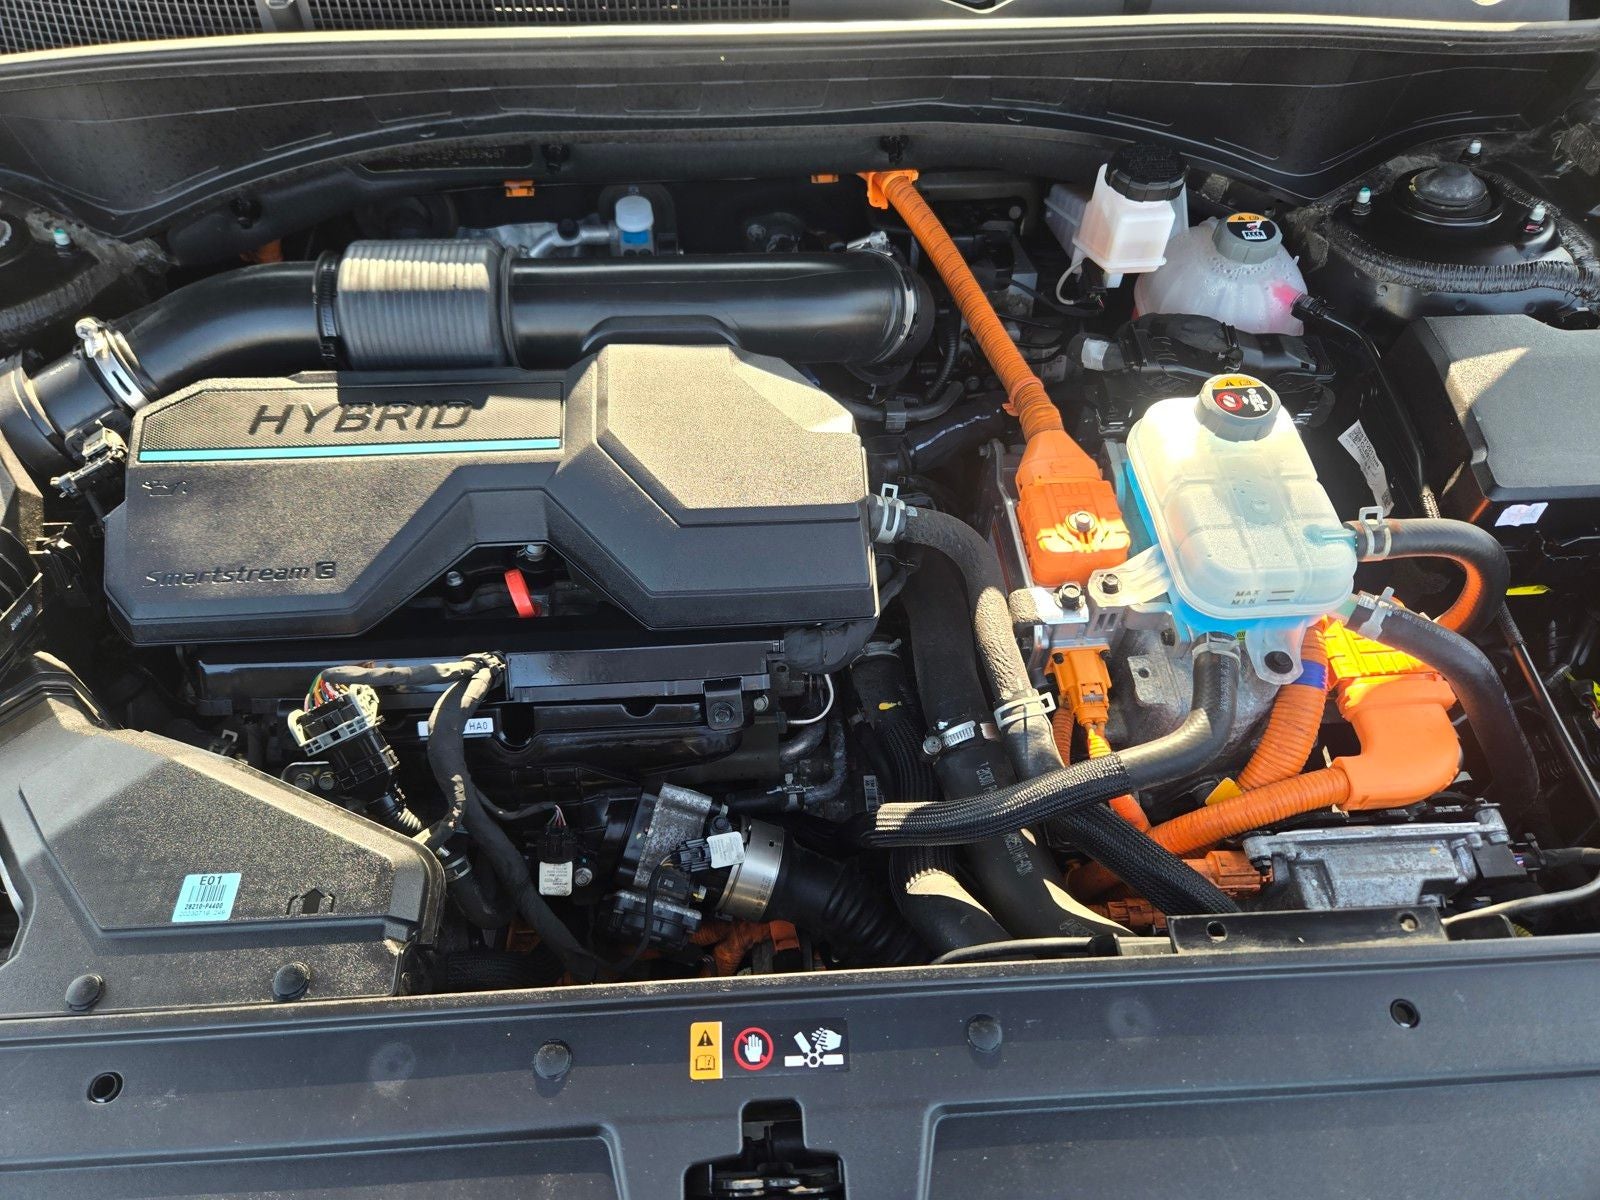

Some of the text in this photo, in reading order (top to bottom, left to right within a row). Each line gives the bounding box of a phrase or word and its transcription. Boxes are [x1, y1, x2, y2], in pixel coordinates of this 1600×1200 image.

[248, 401, 474, 435] HYBRID
[142, 565, 311, 588] Smartstream
[1231, 598, 1256, 606] MIN
